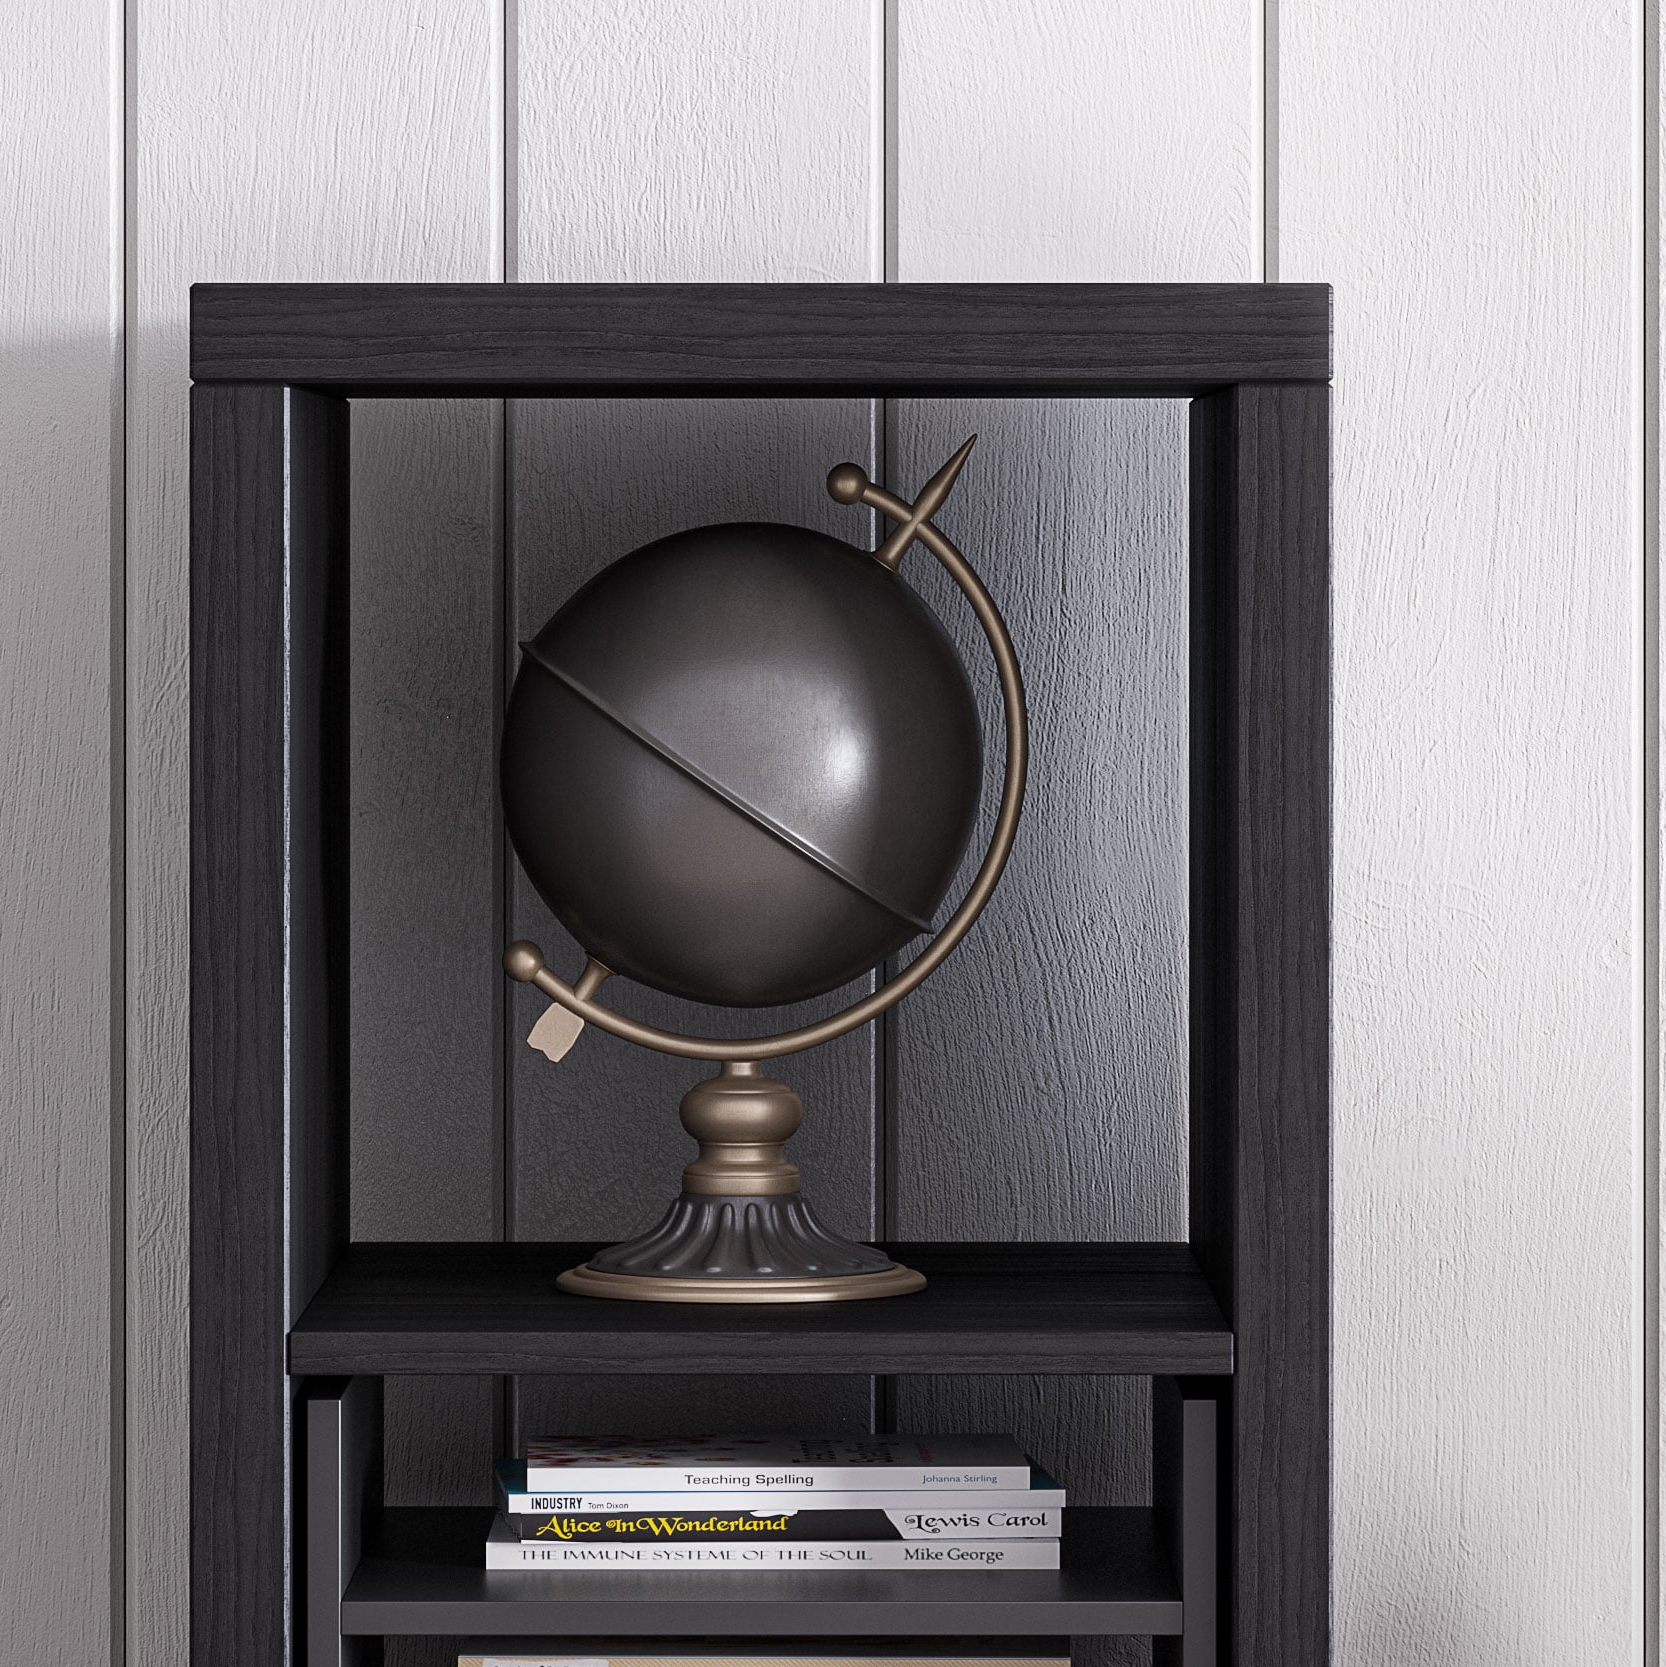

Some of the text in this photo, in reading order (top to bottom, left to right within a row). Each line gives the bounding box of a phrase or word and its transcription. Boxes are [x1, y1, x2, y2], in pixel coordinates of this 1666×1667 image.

[684, 1473, 814, 1488] Teaching Spelling
[922, 1473, 998, 1484] Johanna Stirling
[531, 1497, 583, 1511] INDUSTRY
[588, 1502, 629, 1510] Tom Dixon
[535, 1516, 602, 1539] Alice
[637, 1516, 790, 1536] Wonderland
[903, 1511, 1048, 1533] Lewis Carol
[520, 1550, 873, 1561] THE IMMUNE SYSTEME OF THE SOUL
[904, 1548, 1005, 1565] Mike George
